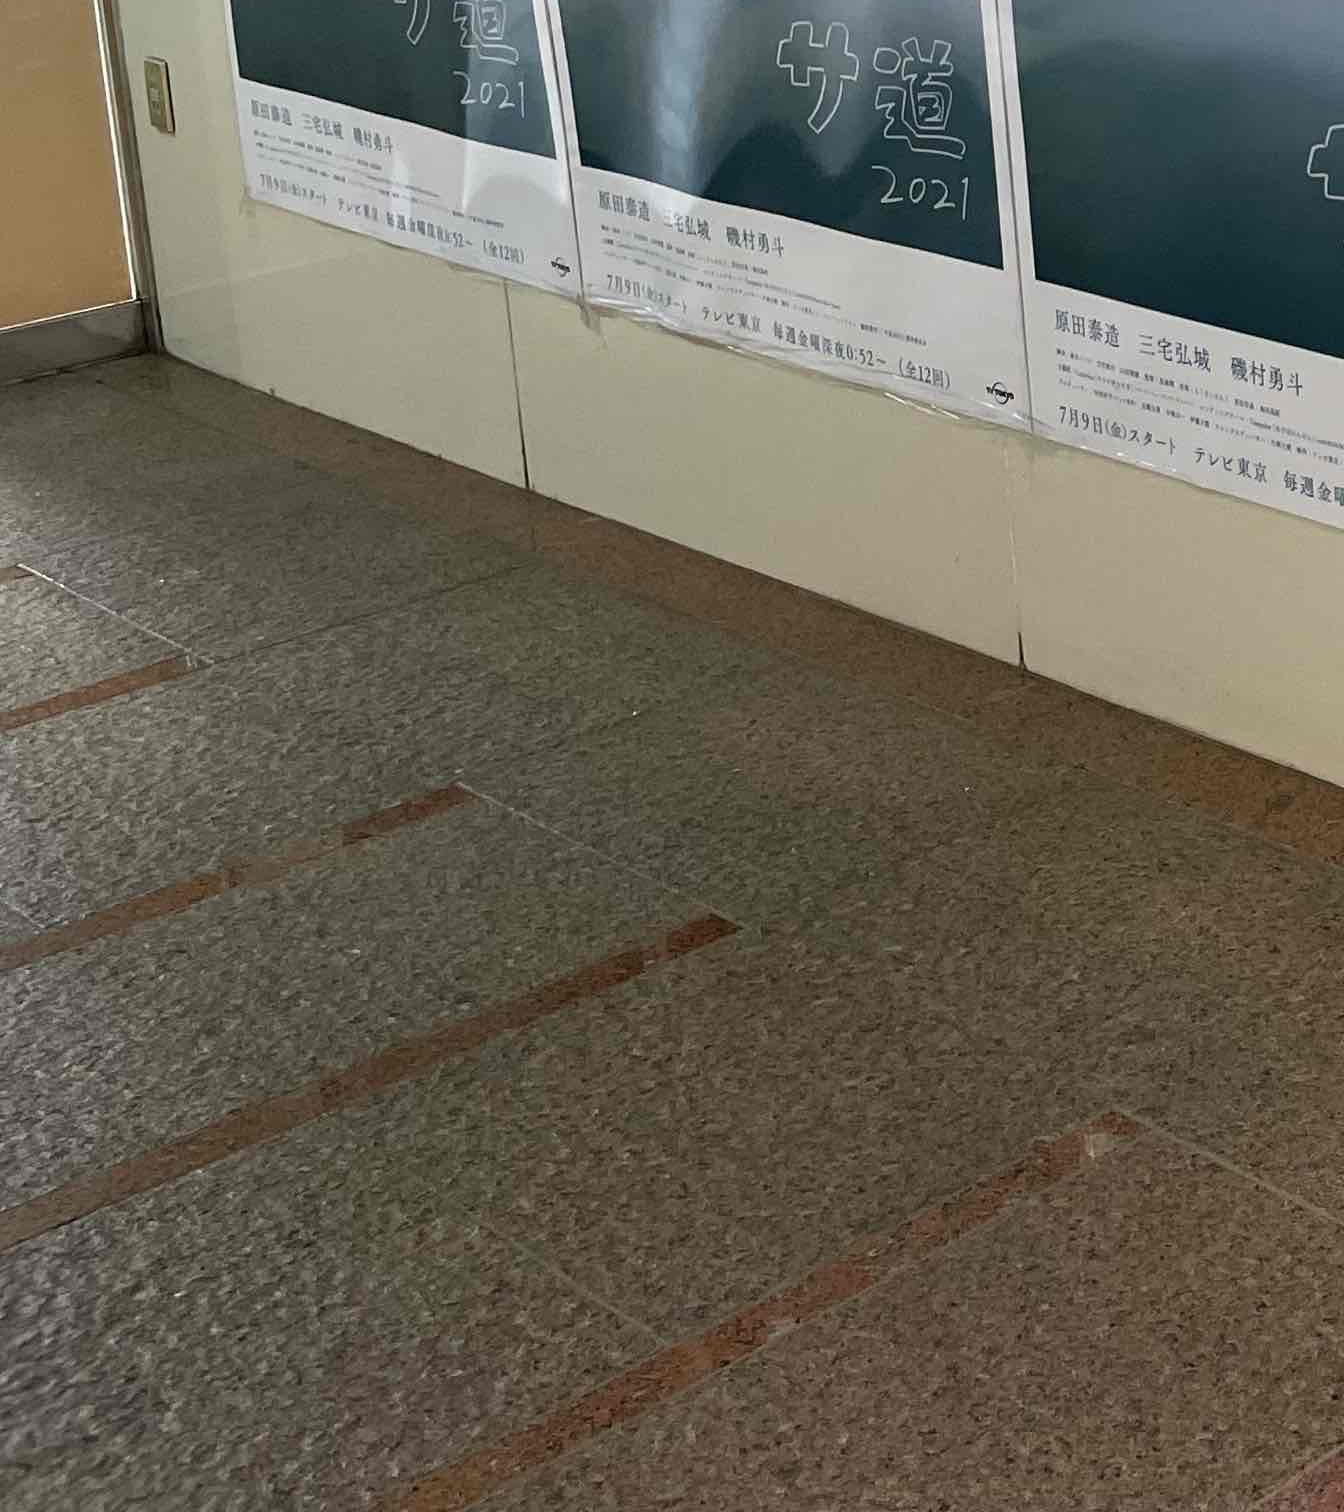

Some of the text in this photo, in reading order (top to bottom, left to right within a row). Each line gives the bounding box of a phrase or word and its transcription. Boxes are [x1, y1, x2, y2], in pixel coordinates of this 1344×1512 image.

[452, 71, 525, 118] 2021
[777, 21, 966, 159] サ道
[871, 165, 968, 220] 2021
[1055, 309, 1120, 347] 原田泰造
[1139, 334, 1211, 373] 三宅弘城
[1230, 356, 1302, 396] 磯村勇斗
[1193, 447, 1267, 483] テレビ東京
